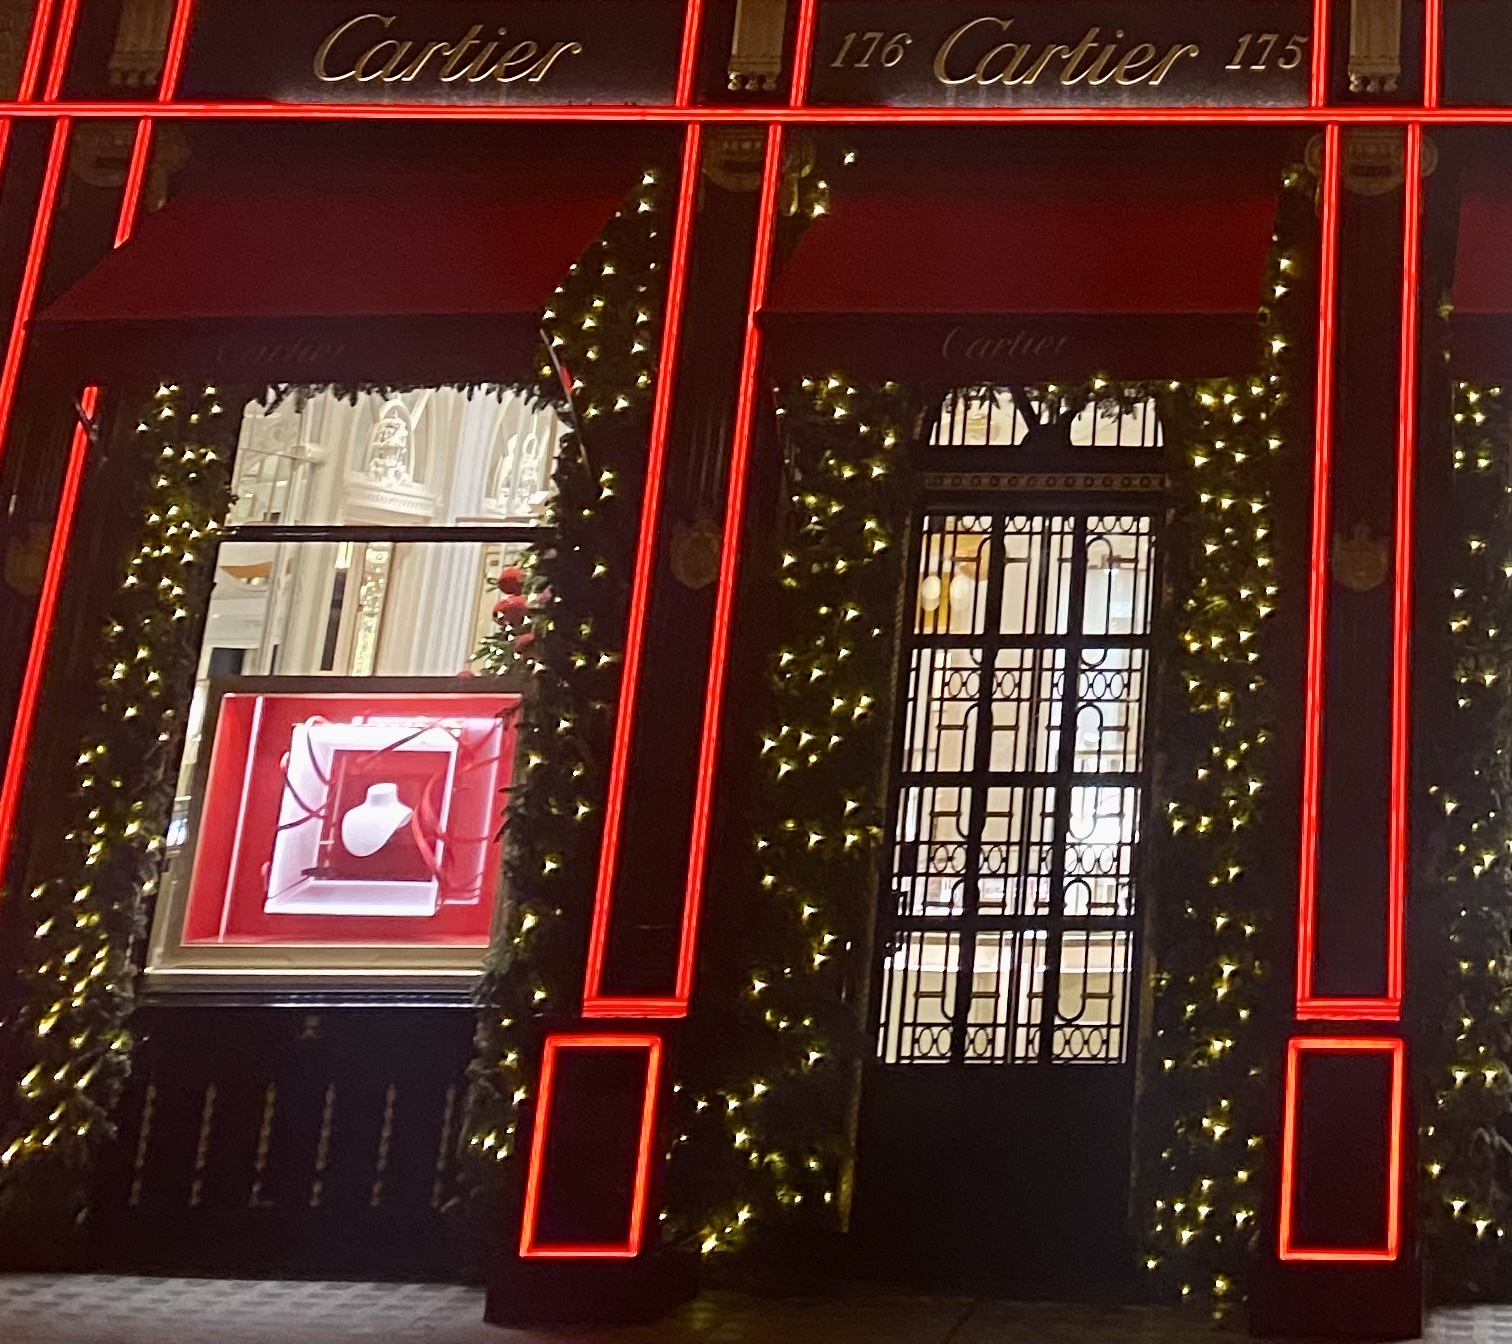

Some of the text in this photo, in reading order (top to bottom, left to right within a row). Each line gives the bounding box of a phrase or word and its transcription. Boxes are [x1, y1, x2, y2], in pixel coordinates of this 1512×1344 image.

[313, 12, 582, 83] Cartier
[829, 16, 1310, 87] 176 Cartier 175
[941, 324, 1070, 361] Cartier
